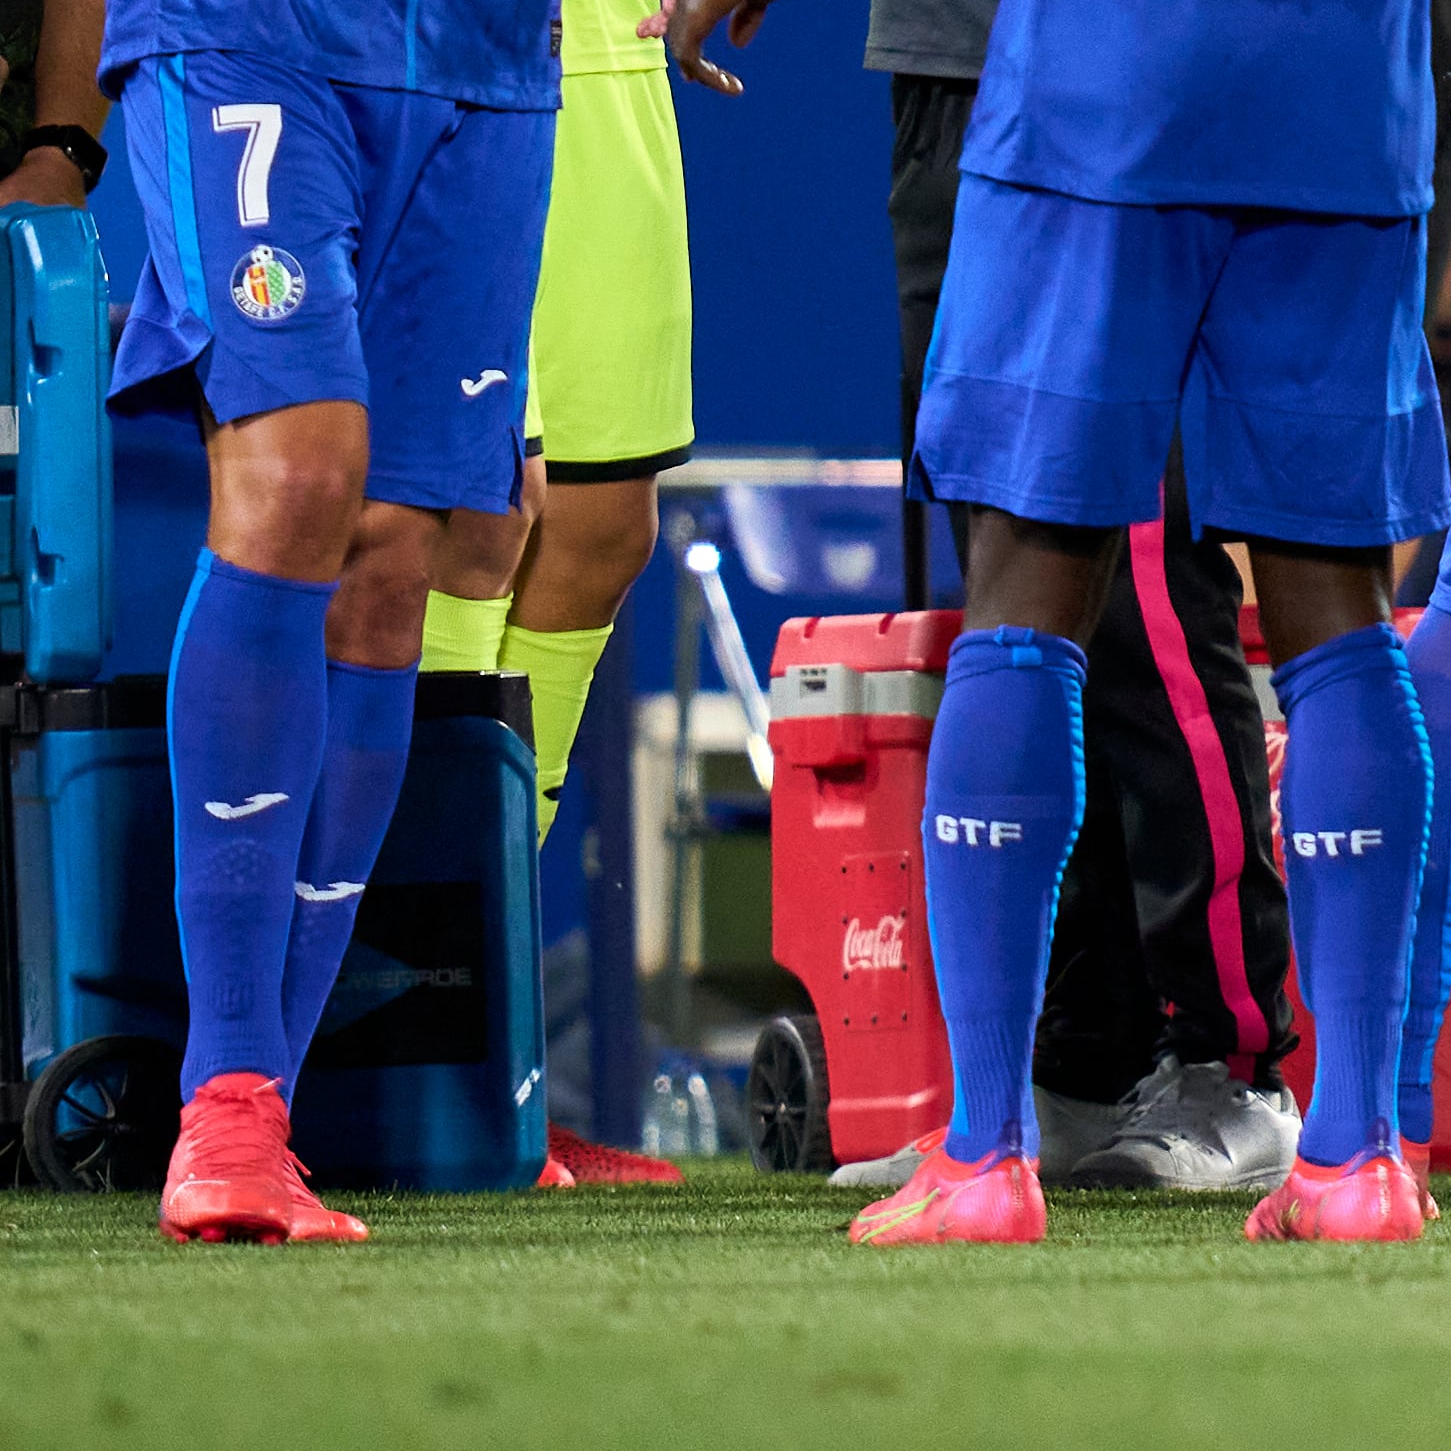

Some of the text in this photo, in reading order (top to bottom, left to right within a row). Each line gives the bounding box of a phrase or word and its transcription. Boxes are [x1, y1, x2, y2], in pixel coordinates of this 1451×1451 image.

[212, 103, 283, 228] 7
[935, 814, 1023, 848] GTF
[1292, 829, 1384, 857] GTF
[334, 967, 472, 991] OWERADE
